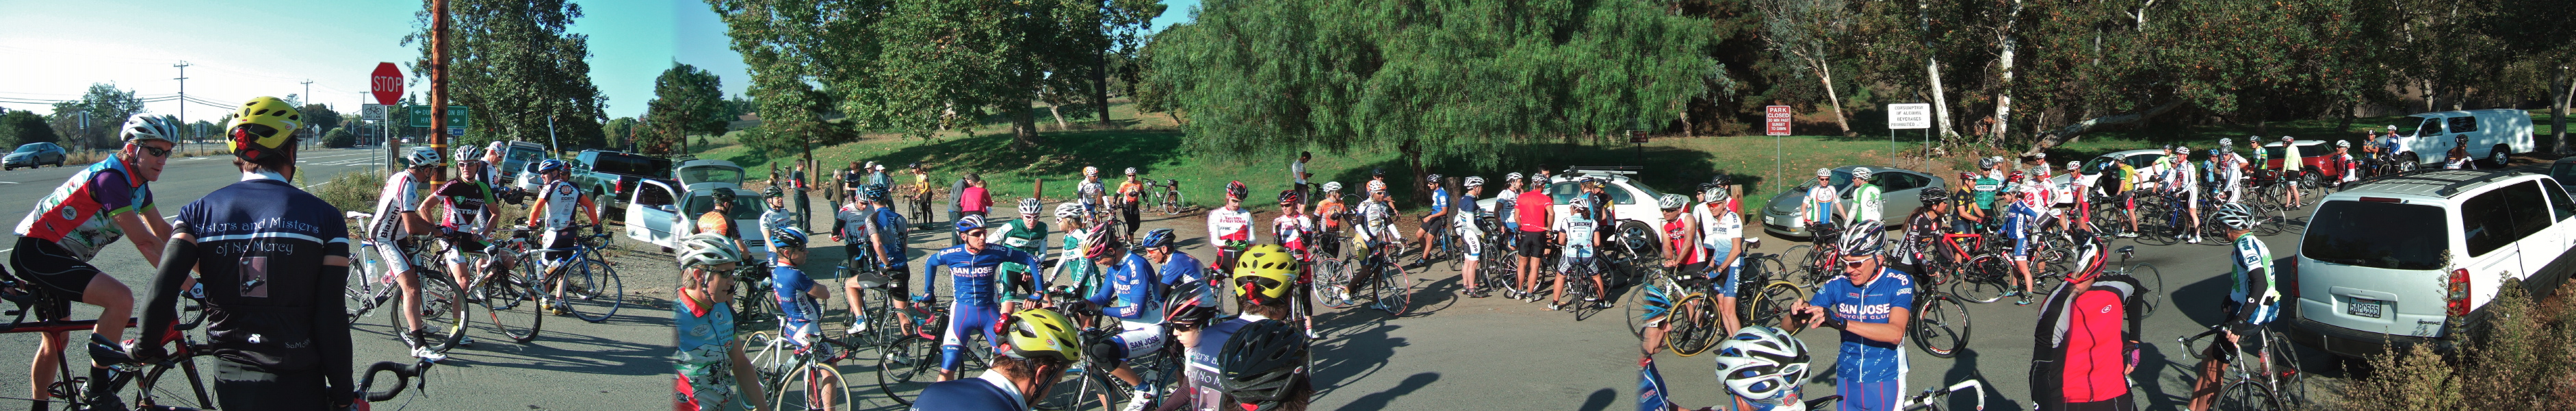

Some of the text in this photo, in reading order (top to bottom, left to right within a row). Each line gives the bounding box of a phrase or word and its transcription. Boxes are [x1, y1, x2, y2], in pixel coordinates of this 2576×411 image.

[374, 76, 402, 92] STOP
[195, 216, 319, 234] Sisters and Misters
[380, 206, 400, 238] Bianchi
[216, 240, 294, 256] of No Mercy
[940, 247, 962, 256] SJBC
[1469, 237, 1479, 252] capo
[1897, 239, 1909, 258] SAFEWAY
[1910, 234, 1918, 254] SAFEWAY
[1886, 272, 1909, 286] SJBC
[1839, 303, 1890, 314] SAN JOSE
[2351, 303, 2379, 314] 5APC555
[1130, 335, 1160, 349] SAN JOSE
[1197, 369, 1212, 382] No
